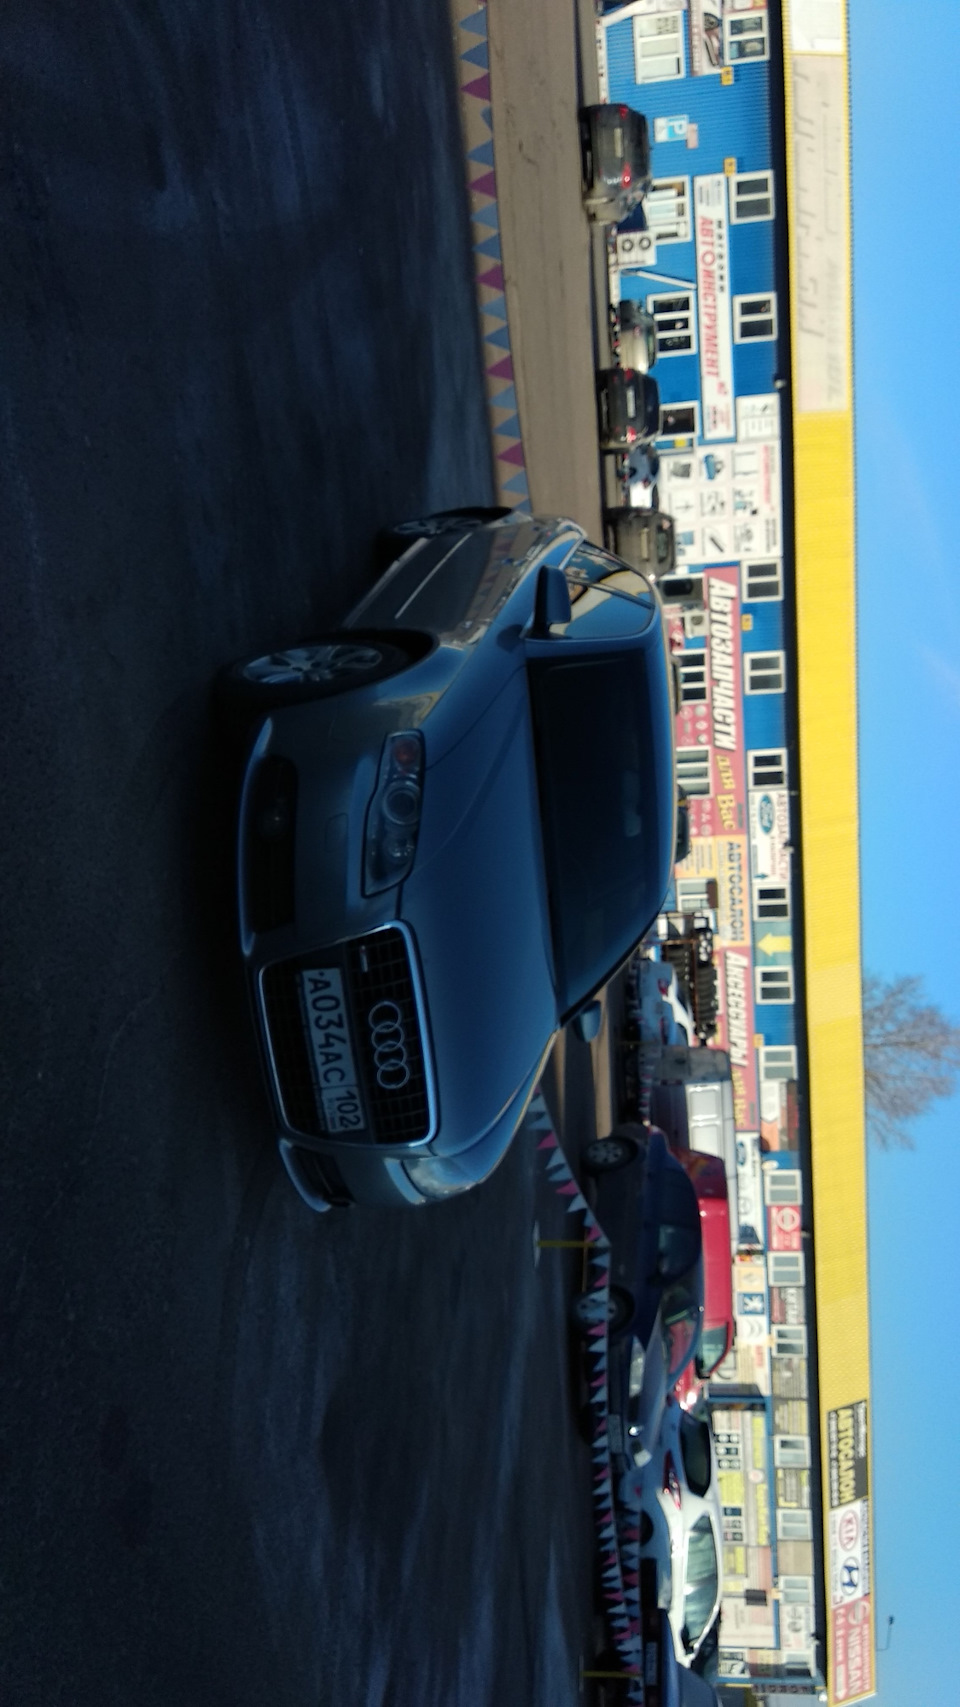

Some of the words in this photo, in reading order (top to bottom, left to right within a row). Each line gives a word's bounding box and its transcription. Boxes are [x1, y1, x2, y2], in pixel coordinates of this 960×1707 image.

[710, 577, 737, 751] АВТОЗАПЧАСТИ
[714, 755, 736, 790] для
[716, 794, 737, 831] Вас
[727, 841, 745, 942] АВТОСАЛОН
[837, 1408, 855, 1503] АВТОСАЛОН
[847, 1627, 862, 1696] NISSAN
